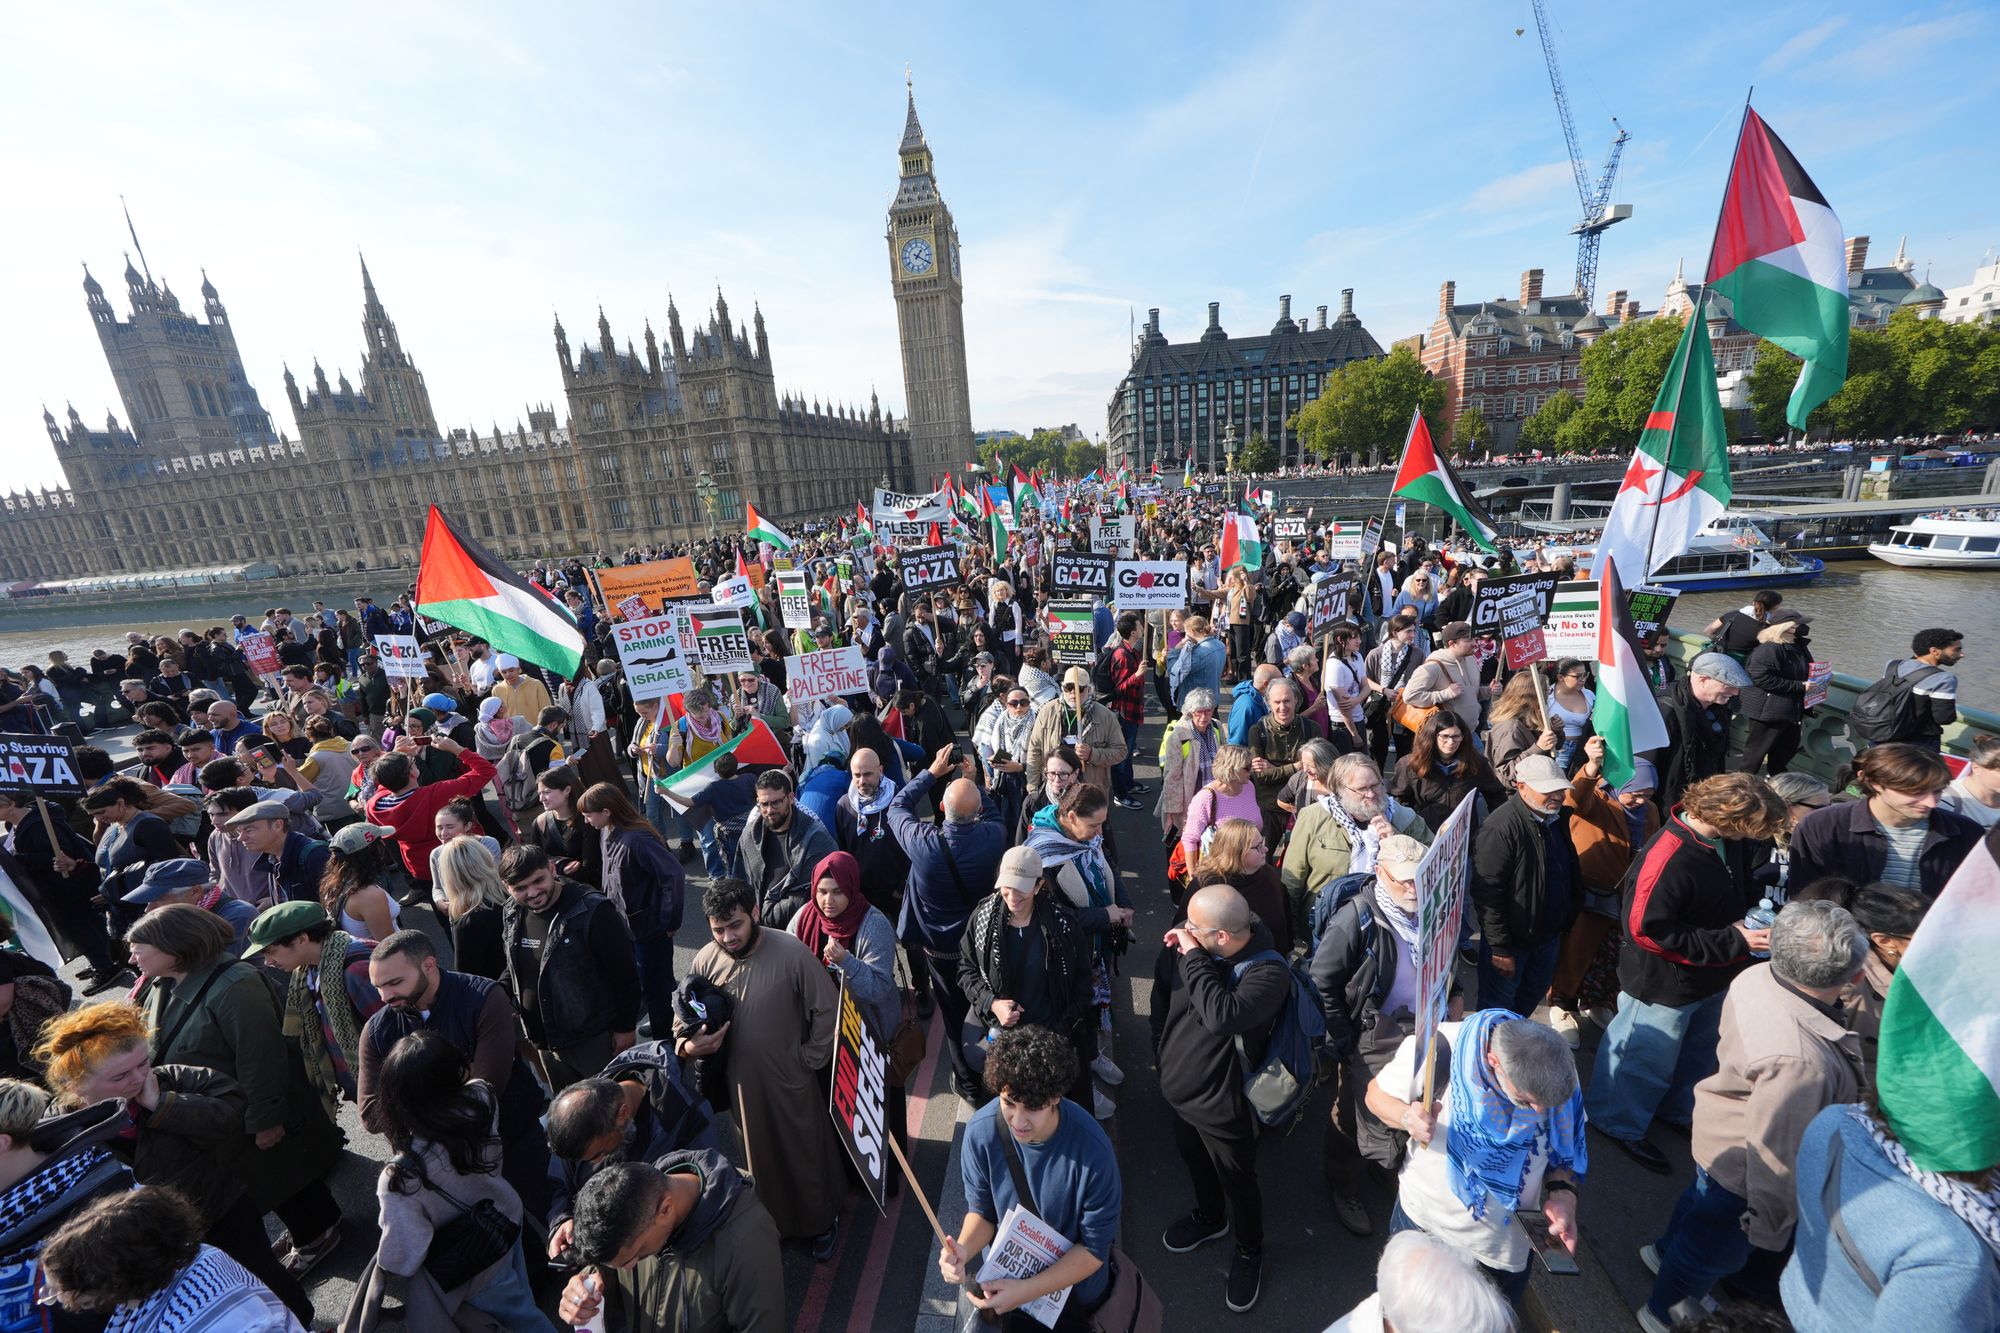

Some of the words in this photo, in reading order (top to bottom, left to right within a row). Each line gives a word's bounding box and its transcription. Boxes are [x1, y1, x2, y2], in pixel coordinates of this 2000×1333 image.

[883, 492, 941, 509] BRISTOL
[1099, 526, 1121, 538] FREE
[1274, 523, 1307, 536] GAZA
[1094, 539, 1131, 549] PALESTINE
[902, 557, 920, 566] Stop
[921, 550, 955, 561] Starving
[1056, 556, 1075, 566] Stop
[1076, 558, 1109, 568] Starving
[903, 560, 958, 587] GAZA
[1055, 566, 1107, 587] GAZA
[632, 589, 657, 598] Justice
[661, 584, 691, 593] Equality
[1480, 587, 1505, 597] Stop
[1508, 580, 1554, 593] Starving
[681, 598, 710, 606] Starving
[782, 596, 808, 610] FREE
[1476, 591, 1546, 625] GA
[1630, 602, 1652, 612] RIVER
[1652, 604, 1662, 613] TO
[1633, 594, 1656, 604] FROM
[1655, 595, 1670, 605] THE
[1314, 592, 1346, 628] GAZA
[1502, 600, 1534, 620] FREEDOM
[1641, 612, 1655, 621] SEA
[619, 620, 671, 641] STOP
[1503, 615, 1540, 638] PALESTINE
[1544, 623, 1557, 631] ay
[1561, 621, 1578, 629] No
[623, 635, 675, 653] ARMING
[696, 634, 747, 653] FREE
[701, 651, 749, 661] PALESTINE
[800, 650, 849, 675] FREE
[632, 667, 685, 685] ISRAEL
[10, 741, 69, 757] Starving
[1421, 850, 1439, 905] FREE
[842, 988, 862, 1058] THE
[834, 1043, 858, 1134] END
[853, 1018, 886, 1181] SIEGE
[1017, 1219, 1046, 1248] Socialist
[1043, 1236, 1066, 1257] Worke
[1004, 1239, 1023, 1260] OUR
[995, 1251, 1025, 1277] MUST
